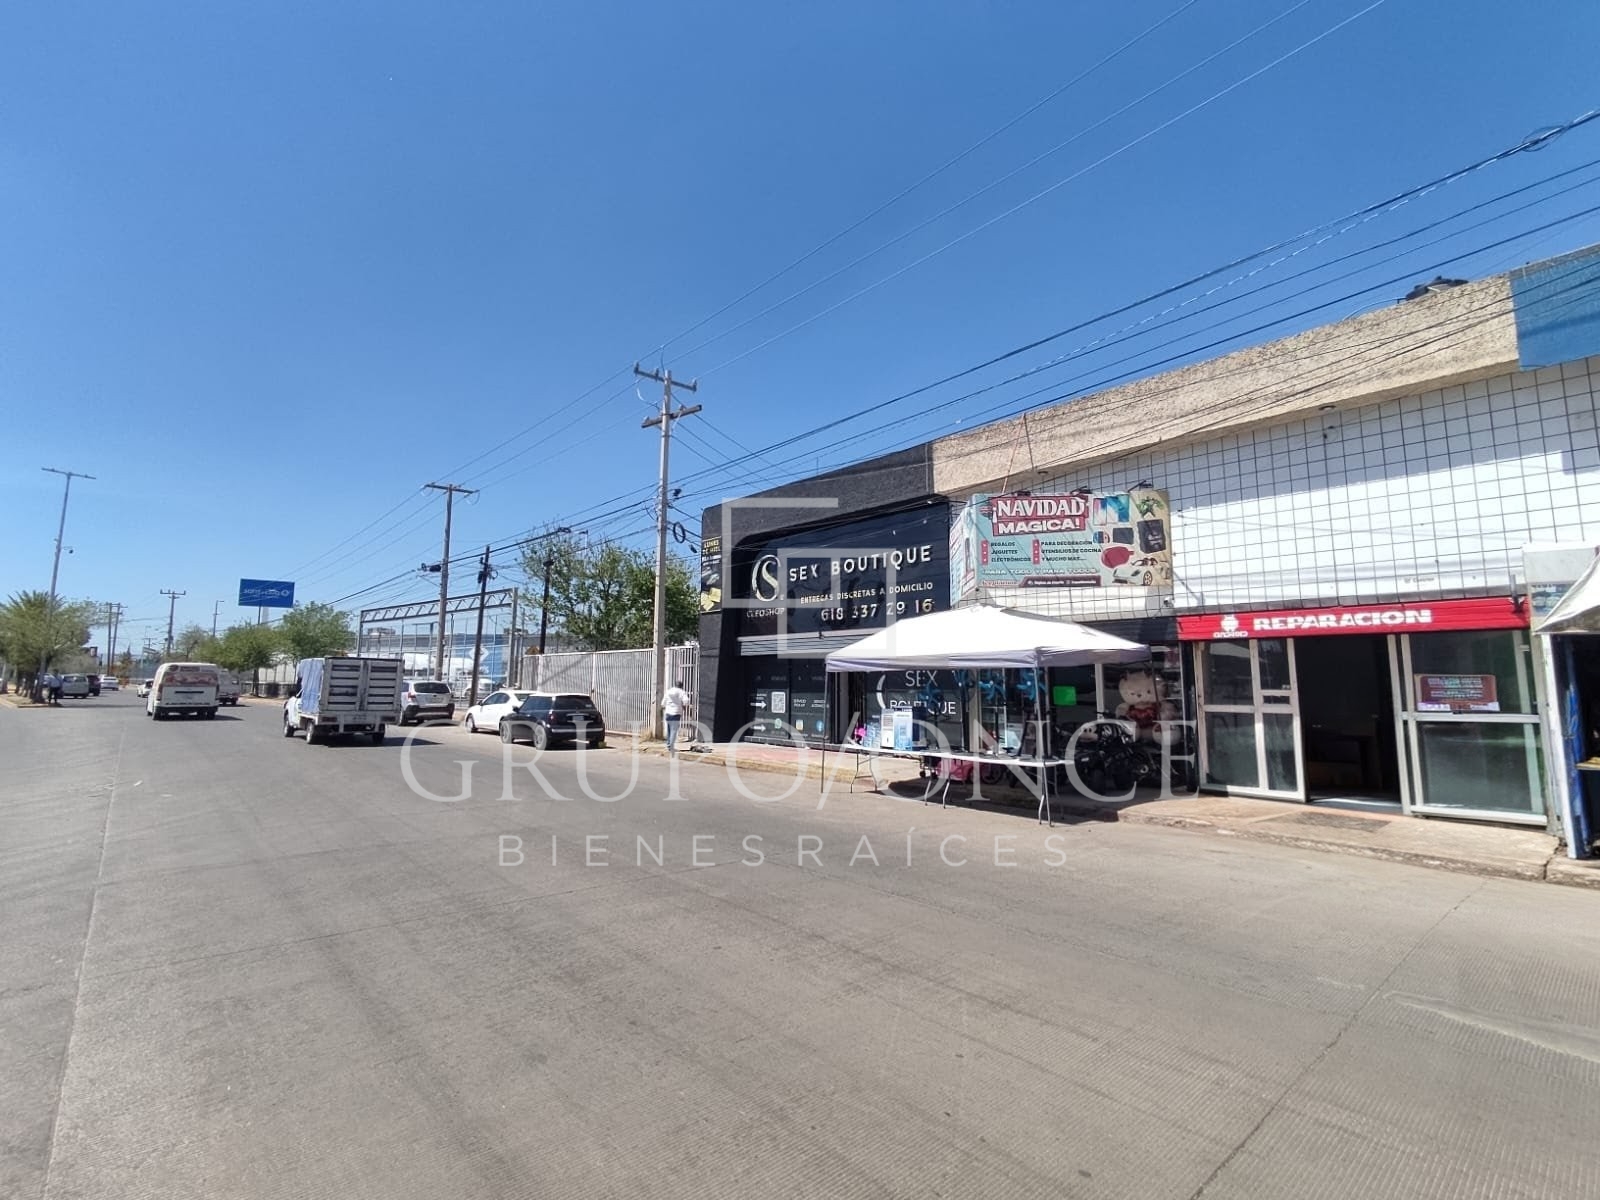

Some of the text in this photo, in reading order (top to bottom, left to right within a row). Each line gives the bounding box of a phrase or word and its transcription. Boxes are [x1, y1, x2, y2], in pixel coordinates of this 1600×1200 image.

[998, 518, 1081, 534] MAGICA!
[789, 544, 933, 582] SEX BOUTIQUE
[836, 588, 876, 600] DISCRETAS
[888, 582, 933, 594] DOMICILIO
[821, 598, 934, 621] 618 337 29 16
[1252, 609, 1433, 632] REPARACION
[905, 670, 938, 687] SEX
